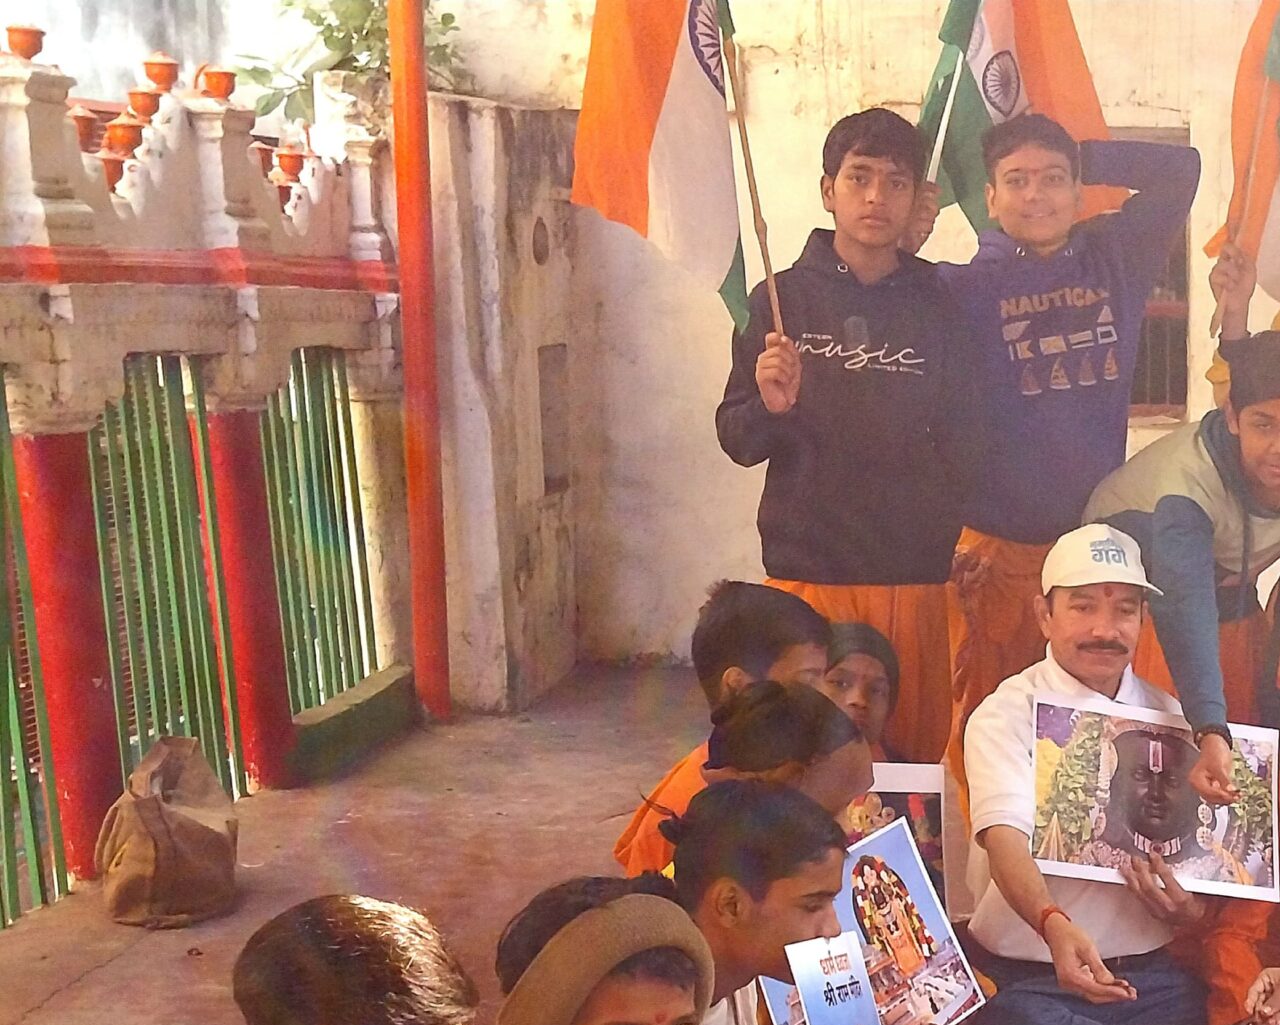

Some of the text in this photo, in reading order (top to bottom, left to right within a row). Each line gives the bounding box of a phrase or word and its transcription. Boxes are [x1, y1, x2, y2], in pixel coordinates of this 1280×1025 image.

[795, 341, 925, 370] music
[823, 981, 838, 1007] श्री
[836, 984, 851, 1003] राम
